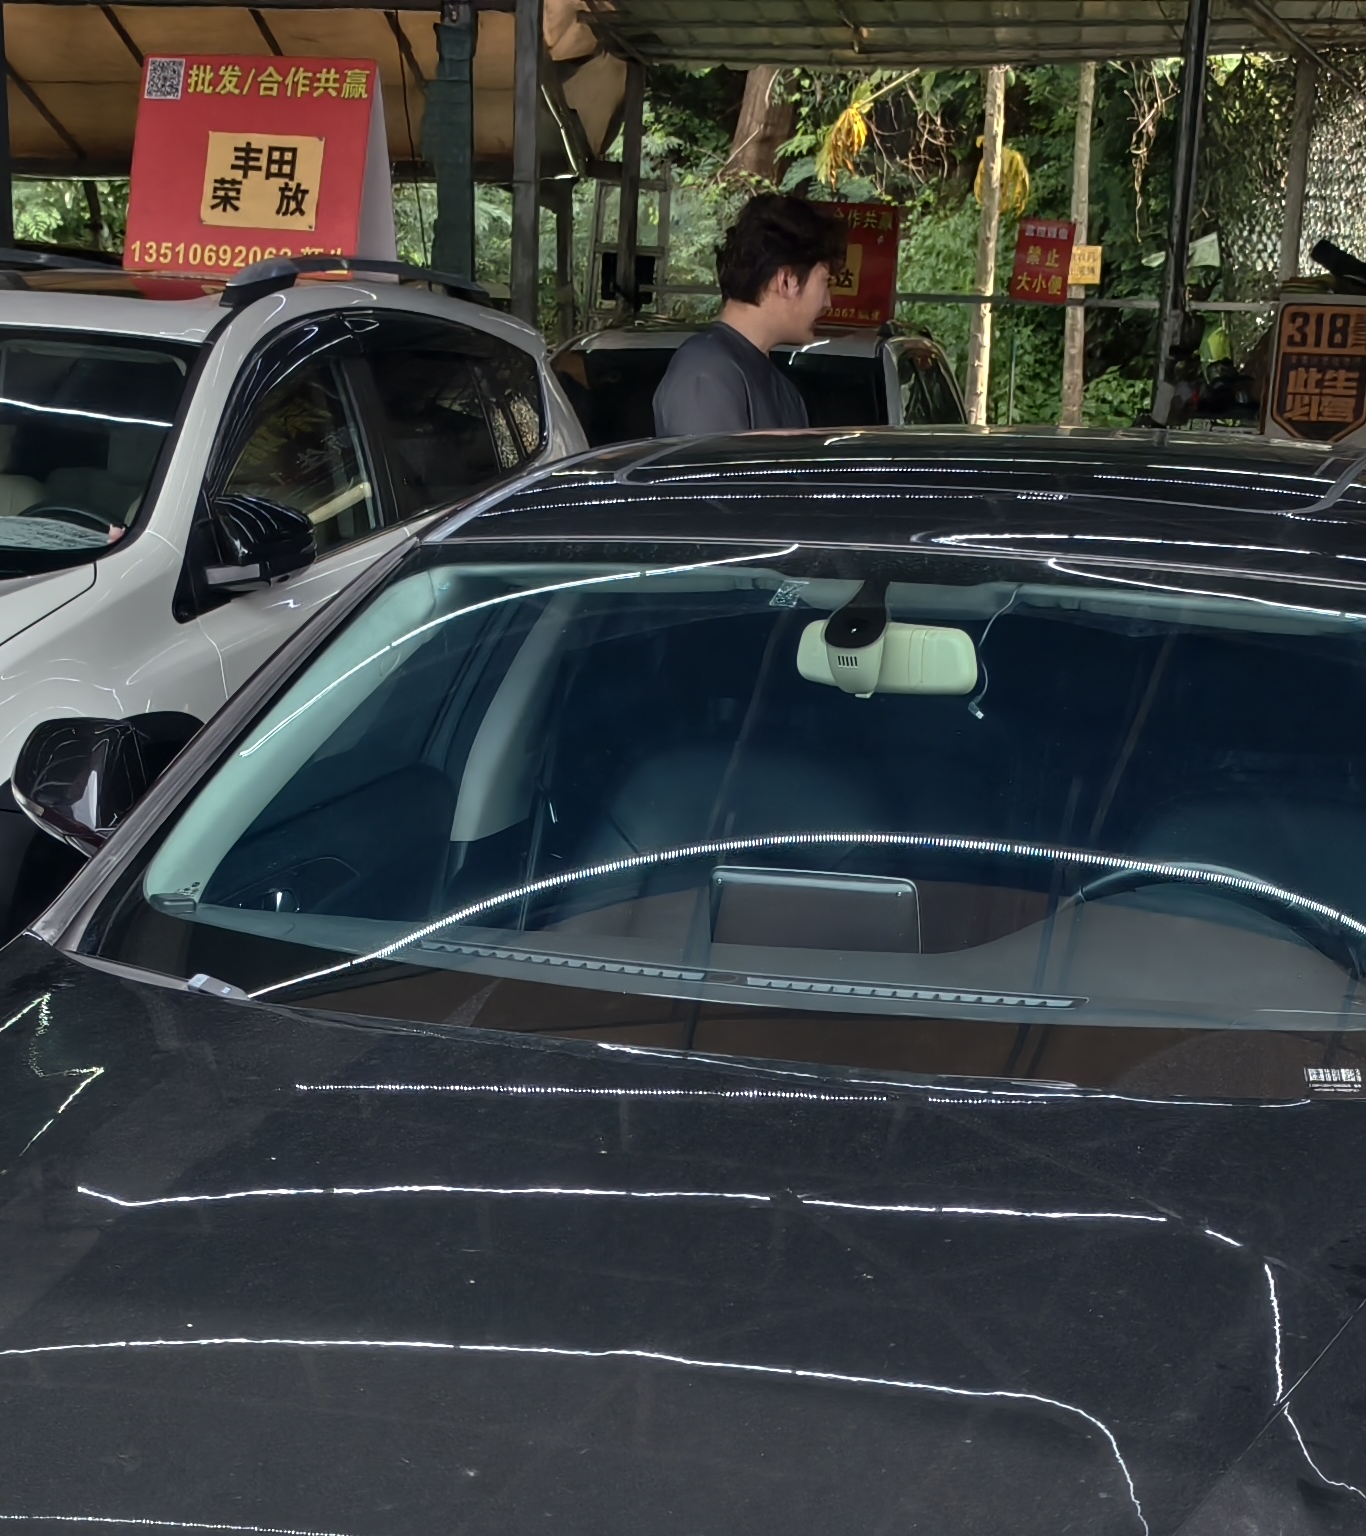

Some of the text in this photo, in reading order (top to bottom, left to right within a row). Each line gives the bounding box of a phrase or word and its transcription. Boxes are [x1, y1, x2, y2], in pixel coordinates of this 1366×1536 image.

[187, 64, 370, 99] 批发/合作共赢
[230, 141, 298, 181] 丰田
[210, 178, 310, 217] 荣放
[1287, 311, 1351, 349] 318
